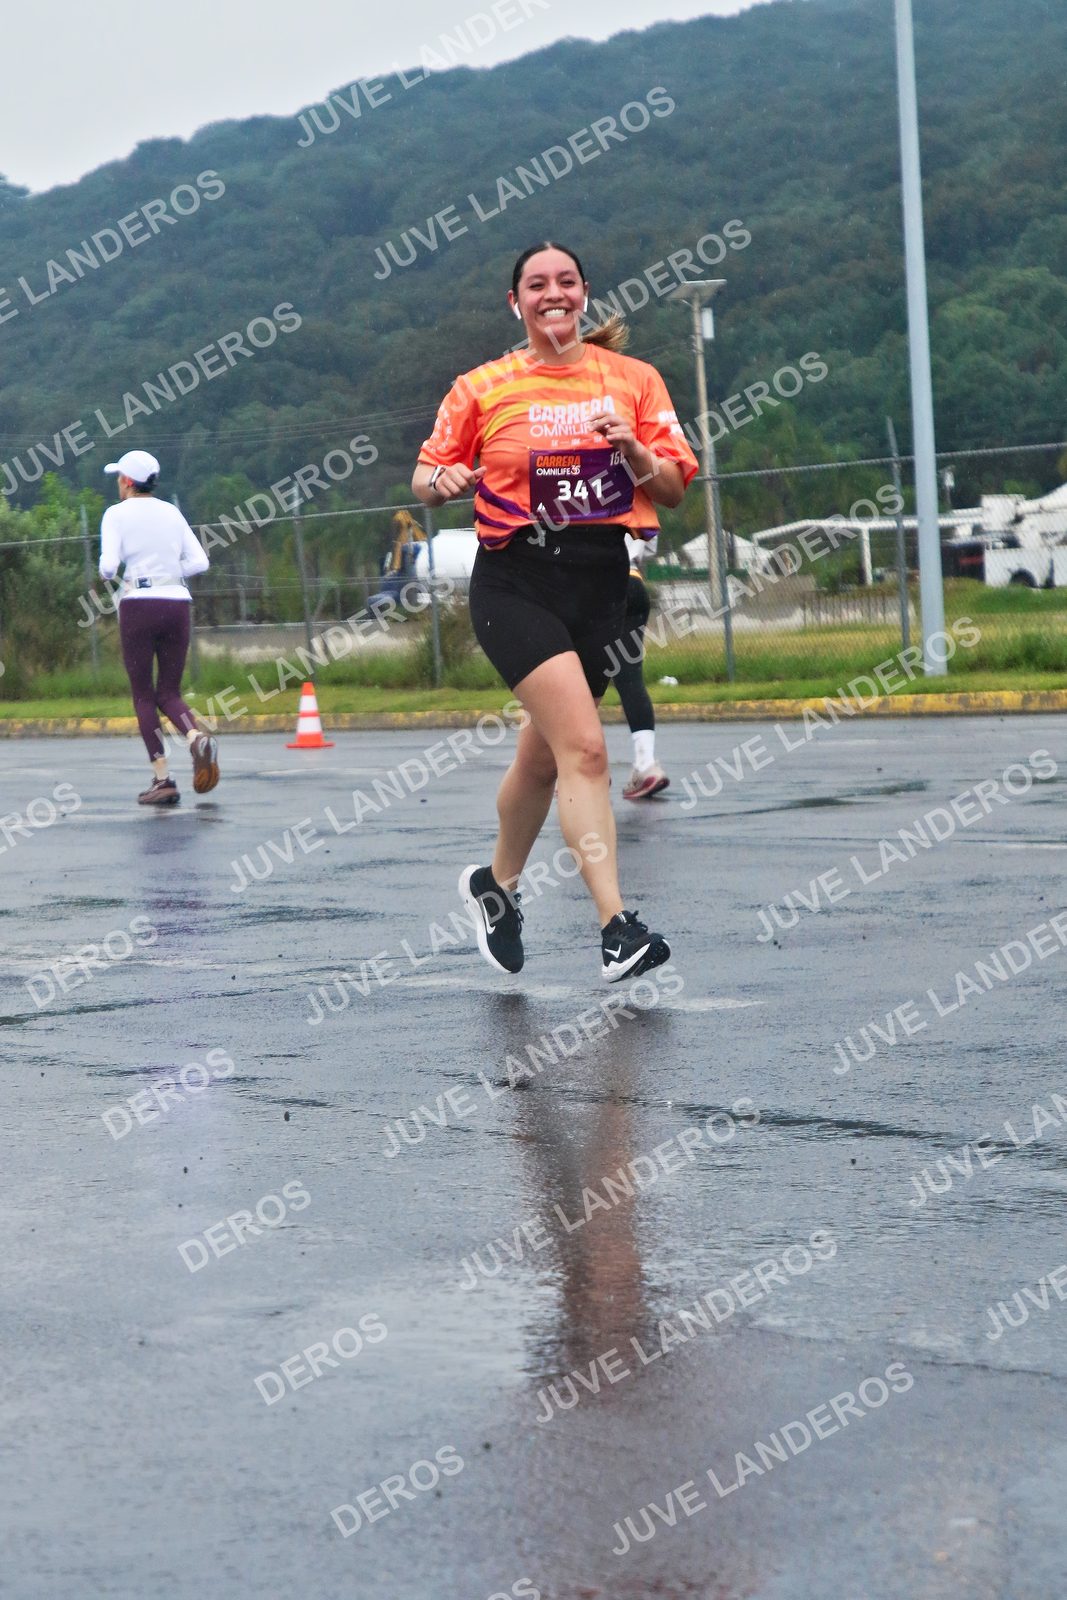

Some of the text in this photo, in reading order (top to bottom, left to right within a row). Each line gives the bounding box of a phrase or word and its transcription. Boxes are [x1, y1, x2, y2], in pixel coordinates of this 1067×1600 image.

[529, 395, 615, 424] CARRERA
[536, 455, 581, 467] CARRERA
[536, 467, 571, 477] OMNILIFE
[557, 478, 603, 501] 341
